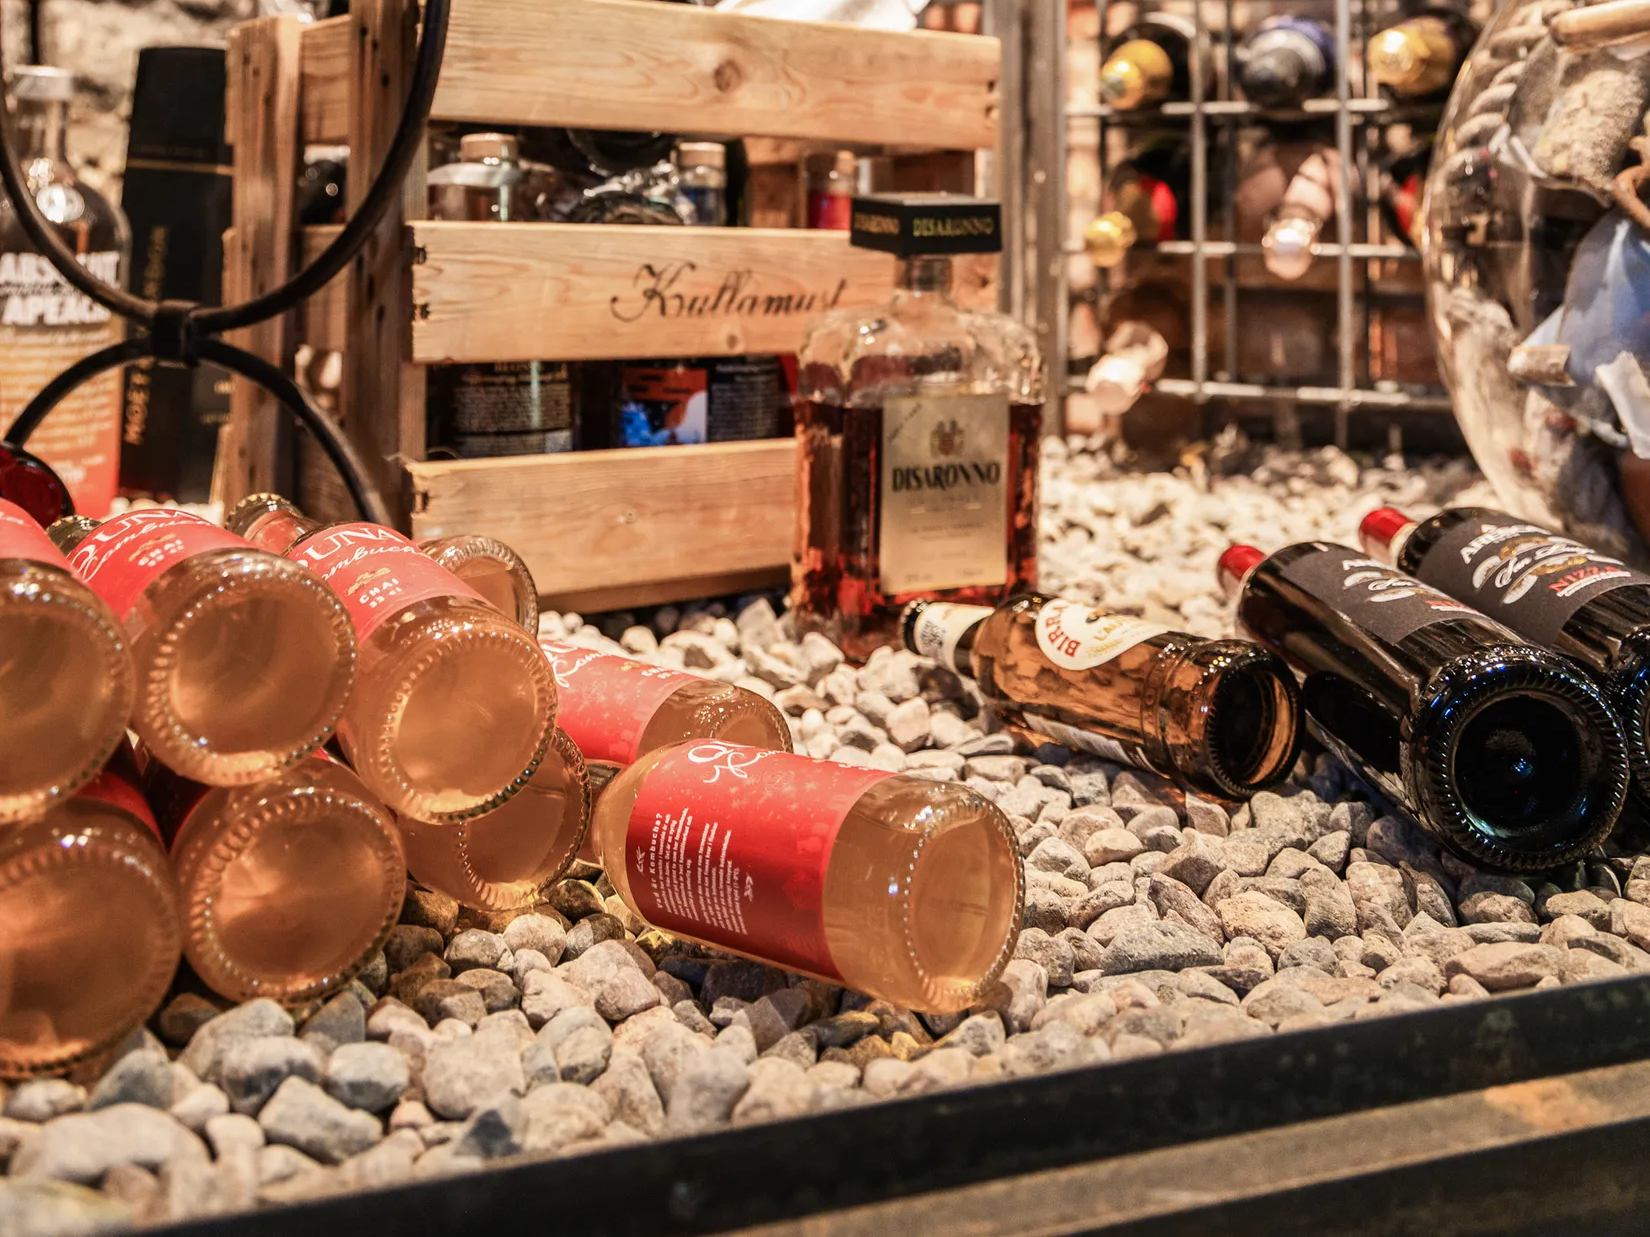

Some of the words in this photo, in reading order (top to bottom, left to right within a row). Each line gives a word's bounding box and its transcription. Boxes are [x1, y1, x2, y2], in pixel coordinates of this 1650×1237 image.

[0, 250, 120, 290] ABSUT
[891, 462, 1001, 492] DISARONNO
[359, 577, 400, 604] CHAI
[369, 595, 386, 609] 33
[648, 812, 662, 874] Kombucha?
[652, 891, 663, 908] Vad
